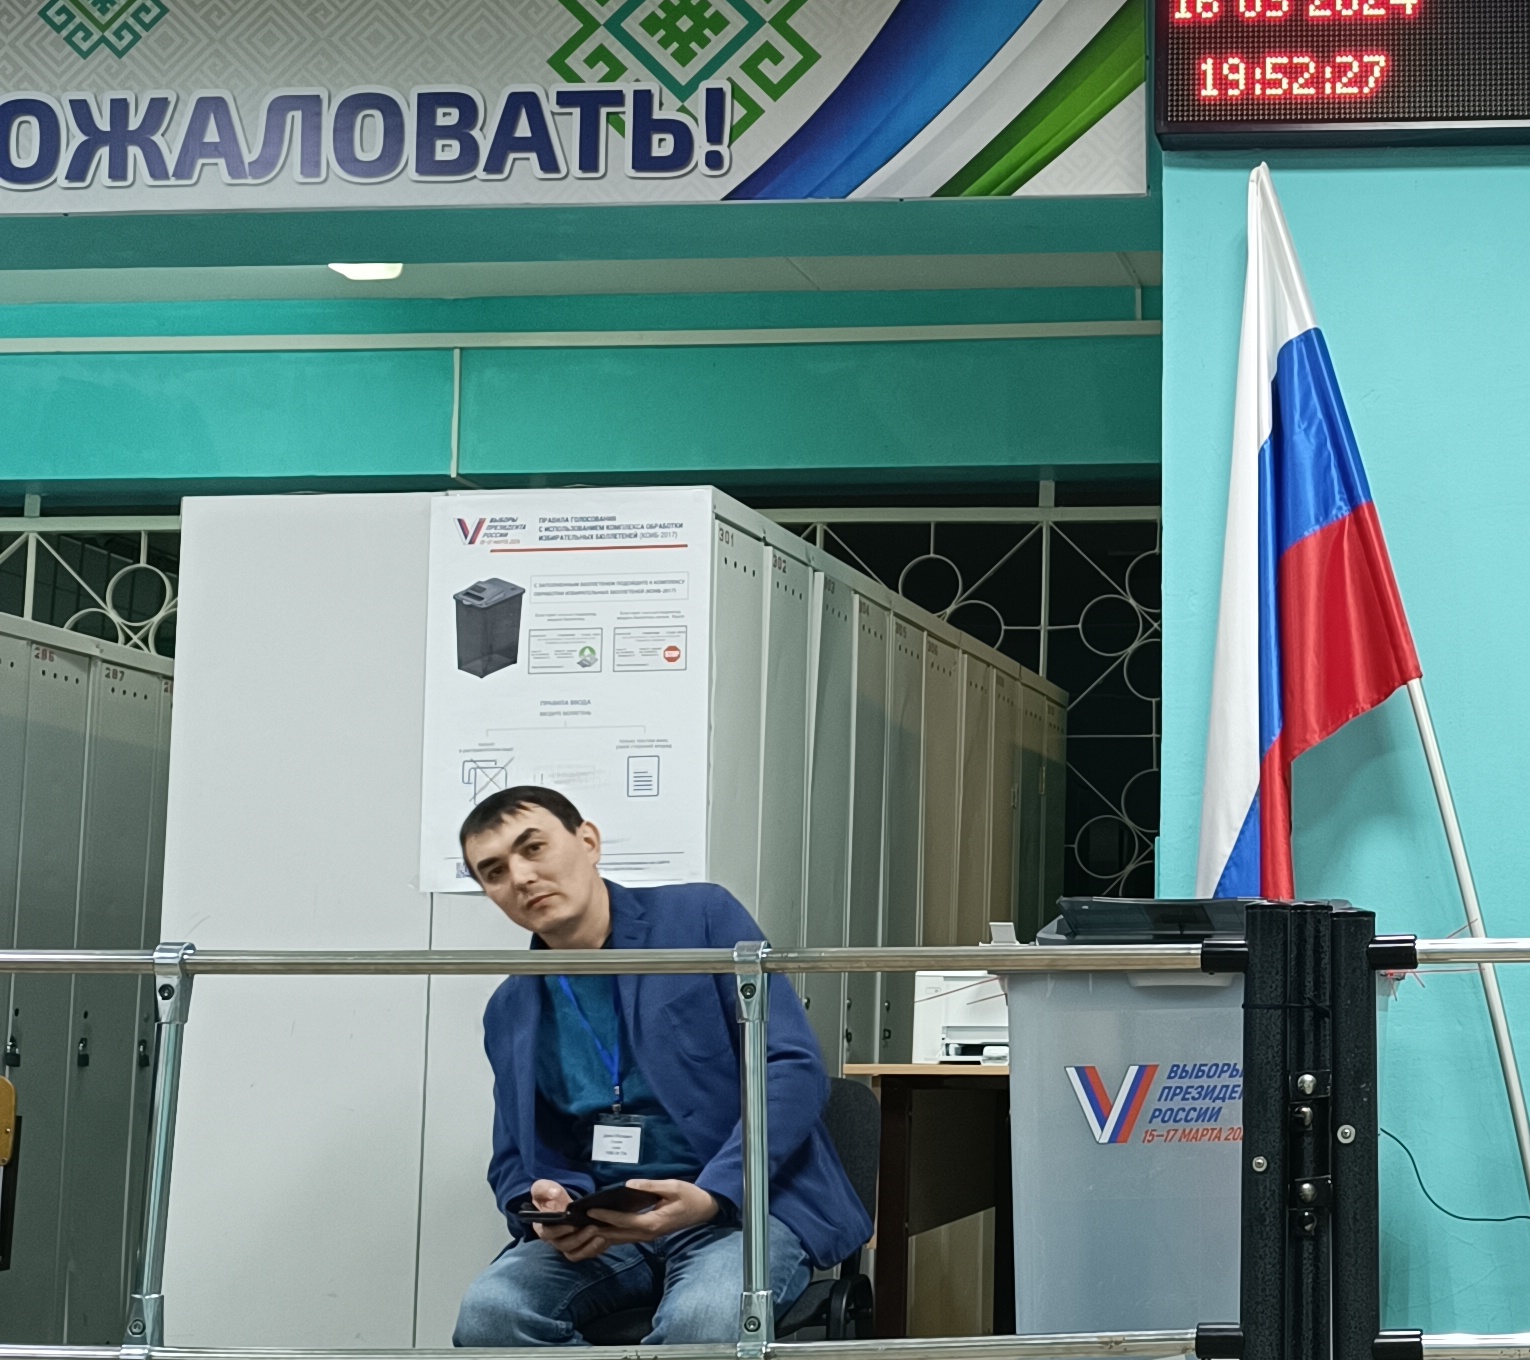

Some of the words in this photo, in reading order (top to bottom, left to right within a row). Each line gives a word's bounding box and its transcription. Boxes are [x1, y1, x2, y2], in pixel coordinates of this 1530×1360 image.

[1199, 54, 1387, 98] 19:52:27
[0, 87, 733, 184] ОЖАЛОВАТЬ!
[719, 527, 735, 547] 301
[772, 553, 787, 574] 302
[1148, 1106, 1223, 1124] РОССИИ
[1180, 1127, 1223, 1143] МАРТА
